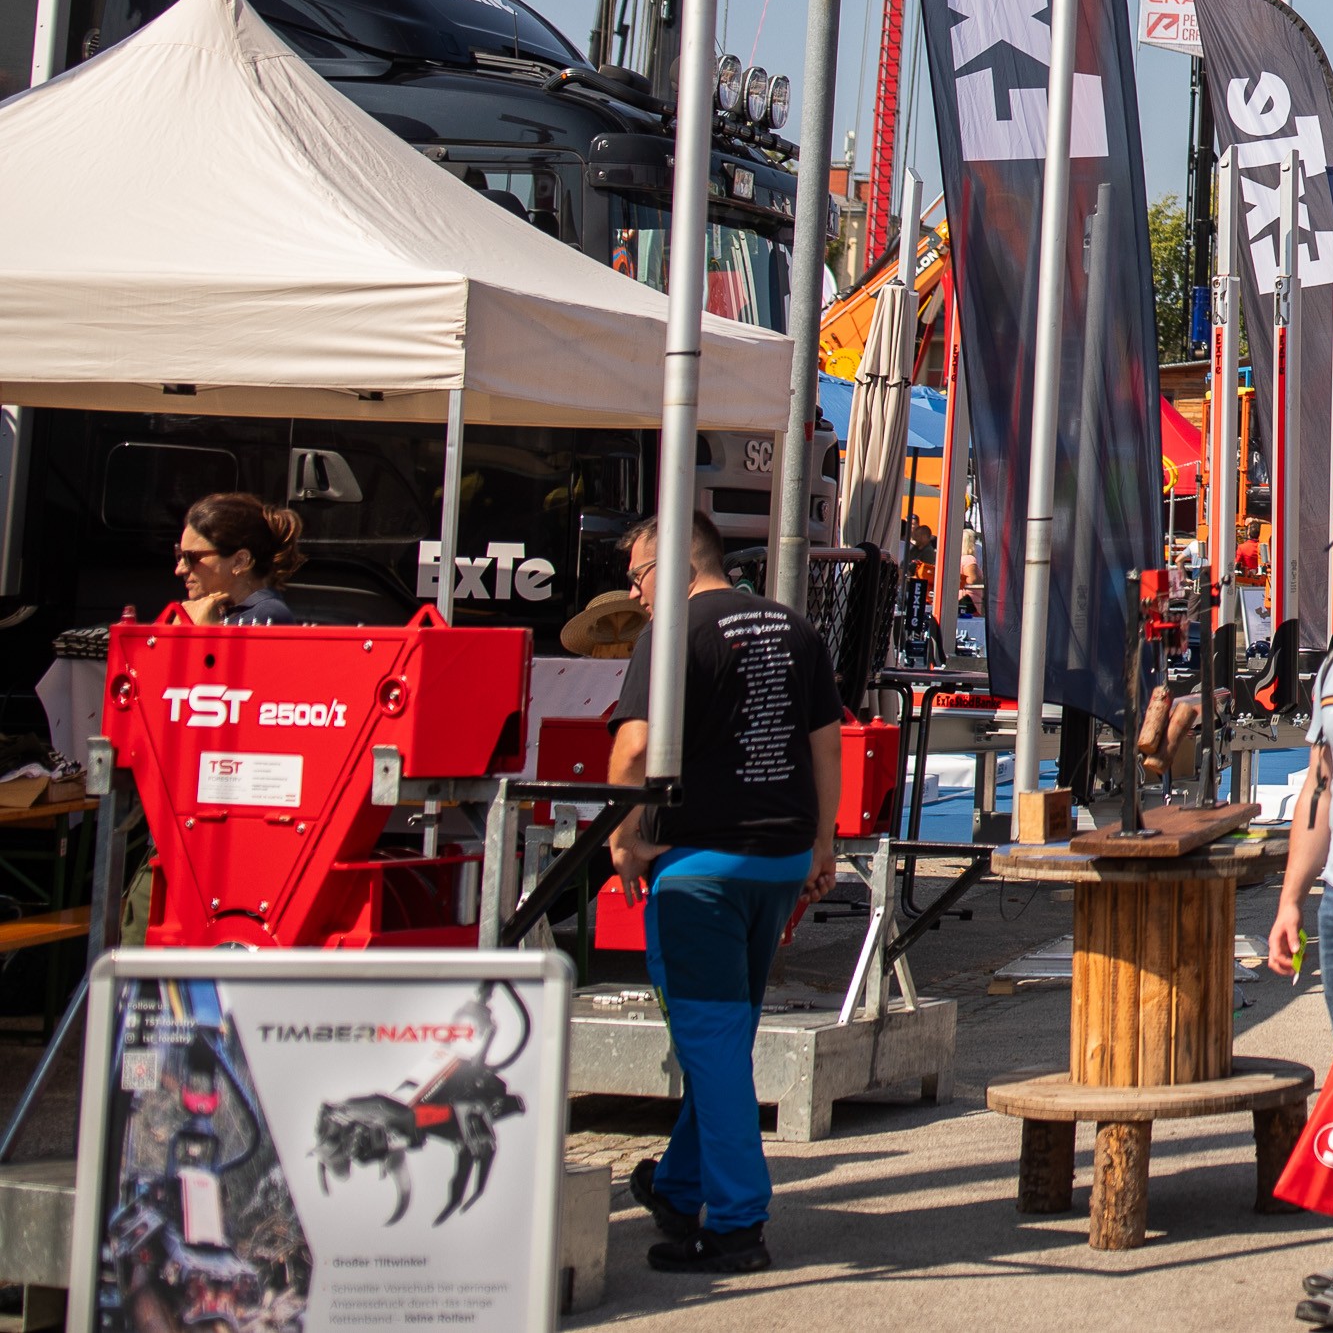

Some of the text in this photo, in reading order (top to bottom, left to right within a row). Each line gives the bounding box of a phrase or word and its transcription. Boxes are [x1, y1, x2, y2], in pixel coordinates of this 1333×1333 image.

[416, 540, 556, 601] ExTe
[162, 684, 253, 727] TST
[208, 759, 243, 775] TST
[257, 1022, 475, 1043] TIMBERNATOR
[332, 1257, 370, 1268] Großer
